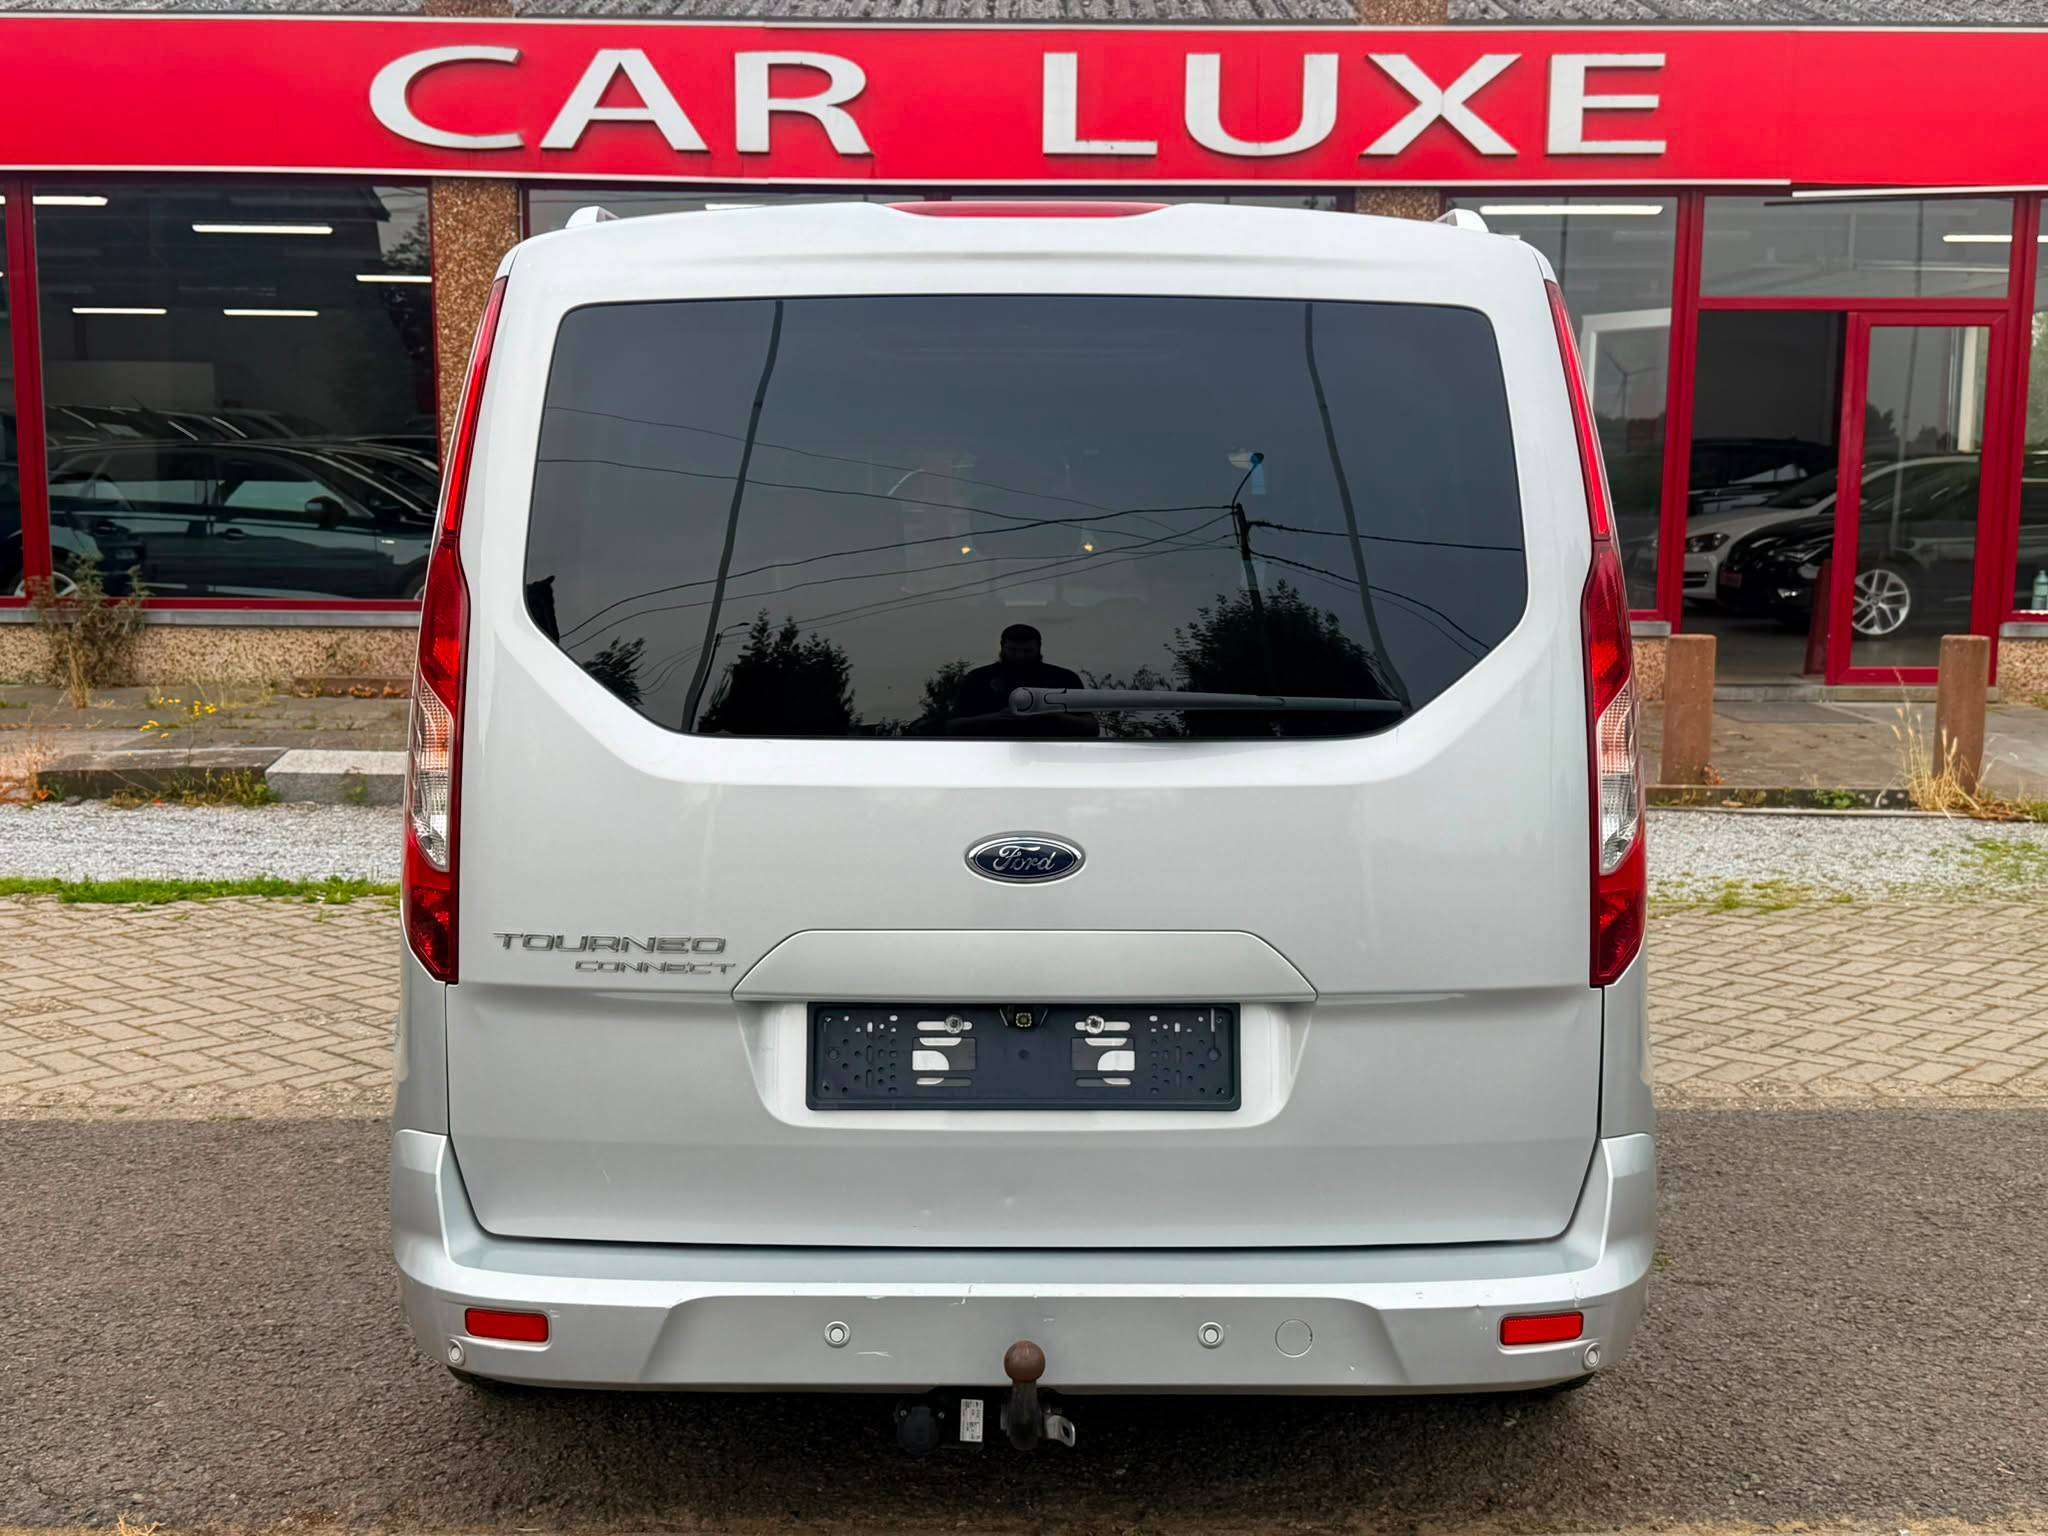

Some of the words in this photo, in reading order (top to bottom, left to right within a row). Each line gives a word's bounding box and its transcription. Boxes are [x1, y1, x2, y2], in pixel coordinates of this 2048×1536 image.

[369, 45, 871, 154] CAR
[1042, 52, 1668, 156] LUXE
[993, 845, 1056, 871] Ford
[493, 932, 727, 954] TOURNEO
[575, 960, 737, 975] CONNECT
